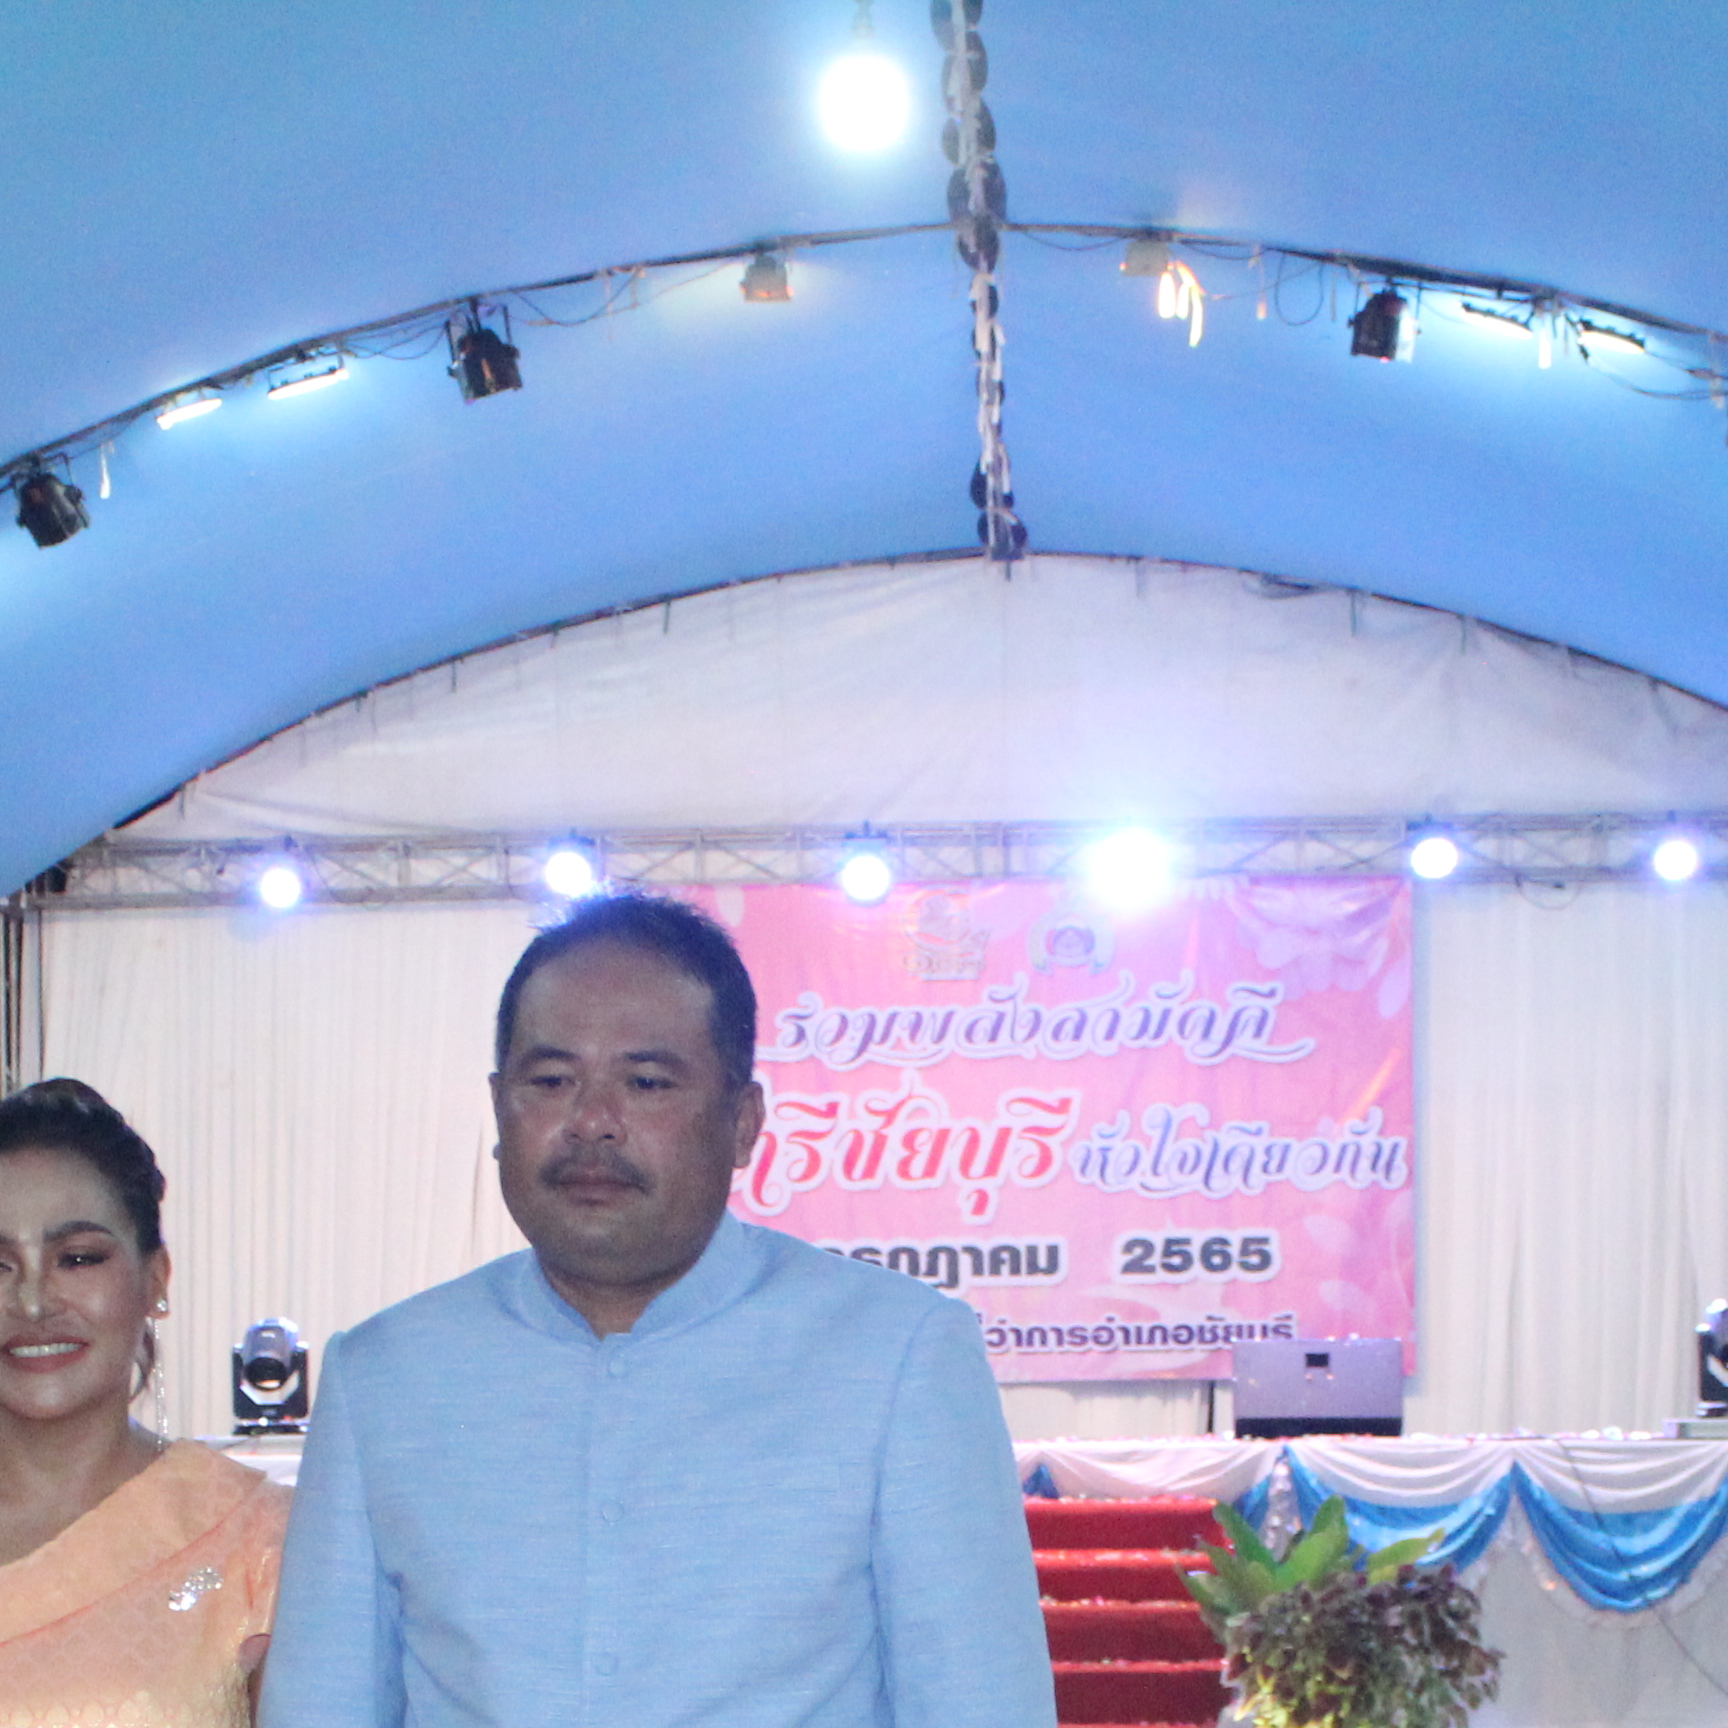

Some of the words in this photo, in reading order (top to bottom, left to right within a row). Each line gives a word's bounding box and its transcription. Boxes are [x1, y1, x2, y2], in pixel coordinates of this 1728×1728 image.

[733, 1088, 1074, 1217] รีชัยบุรี
[1072, 1106, 1406, 1194] หัวใจเดียวกัน
[820, 1243, 1060, 1289] รกฎาคม
[1121, 1235, 1273, 1275] 2565
